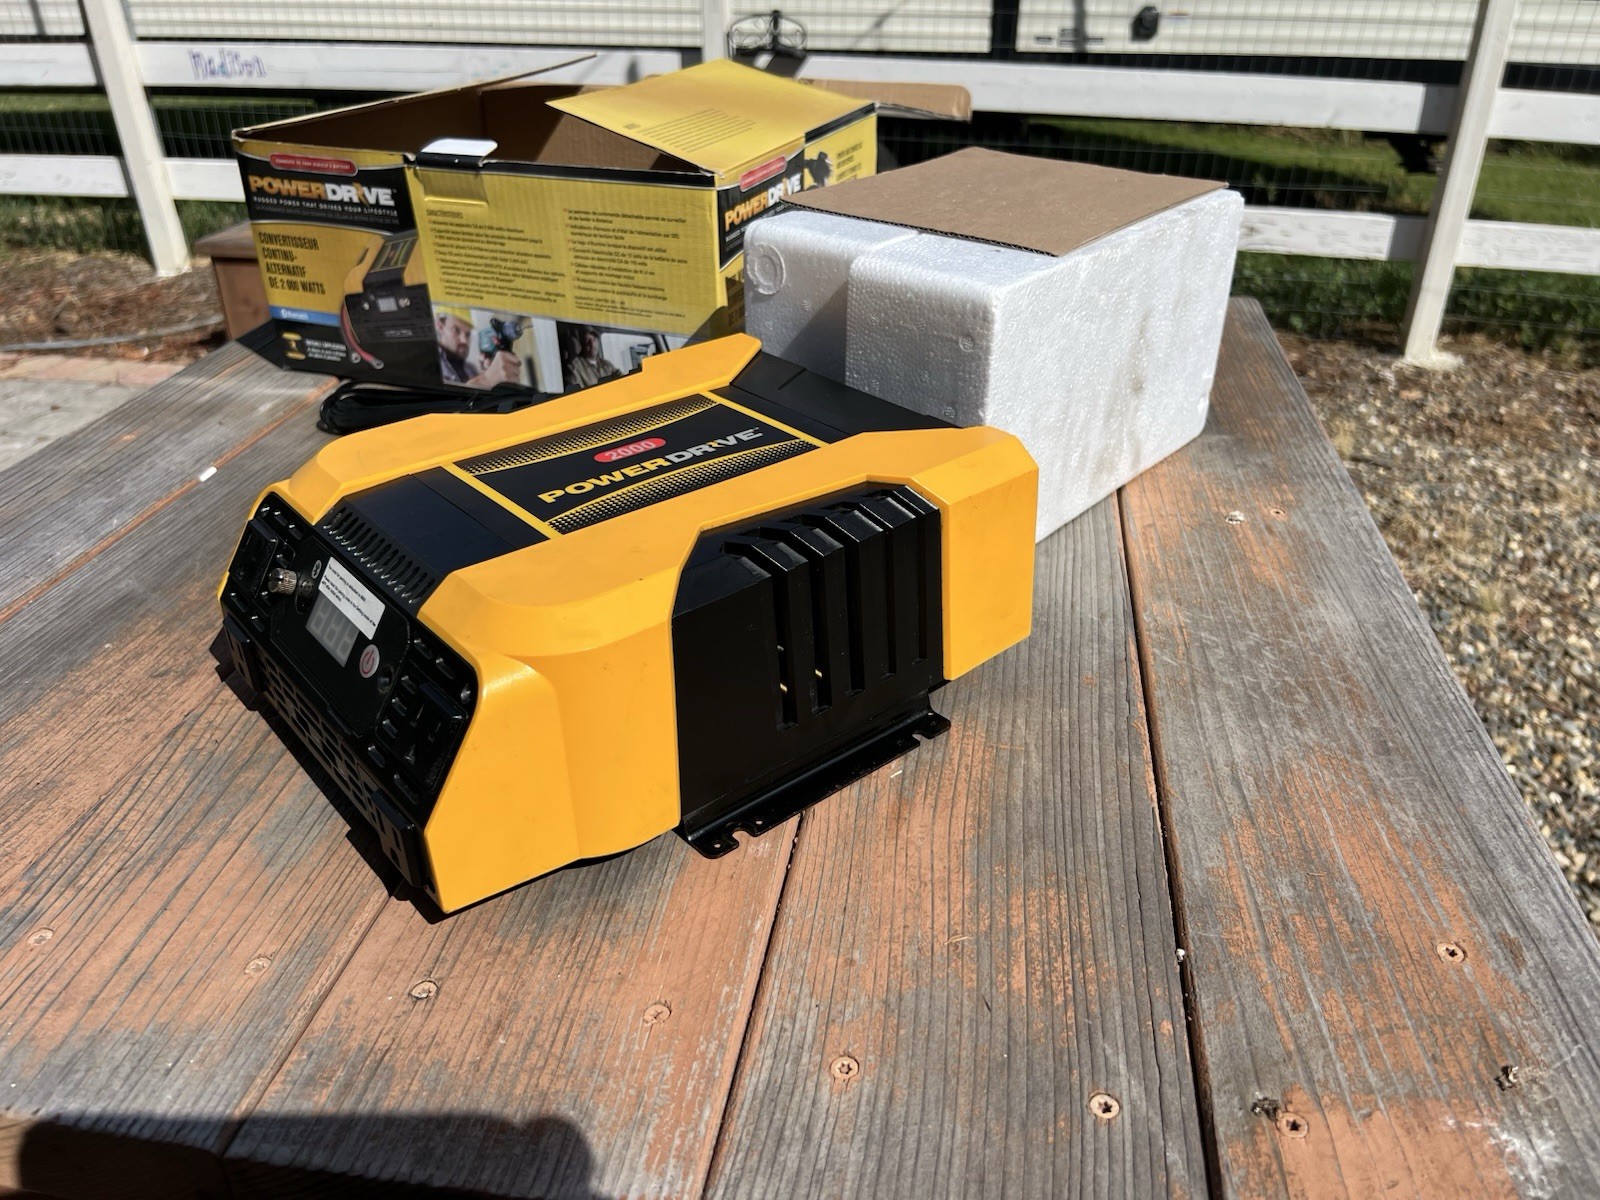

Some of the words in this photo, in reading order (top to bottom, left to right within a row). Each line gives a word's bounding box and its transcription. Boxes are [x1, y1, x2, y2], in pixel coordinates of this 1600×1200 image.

[248, 175, 396, 207] POWERDRIVE
[279, 199, 300, 207] POWER
[318, 203, 342, 211] DRIVES
[363, 208, 398, 216] LIFESTYLE
[259, 232, 319, 250] CONVERTISSEUR
[262, 247, 297, 262] CONTINU-
[266, 262, 306, 278] ALTERNATIF
[268, 276, 279, 289] DE
[280, 278, 285, 290] 2
[300, 281, 326, 295] WATTS
[604, 440, 656, 462] 2000
[537, 427, 764, 503] POWERDRIVE
